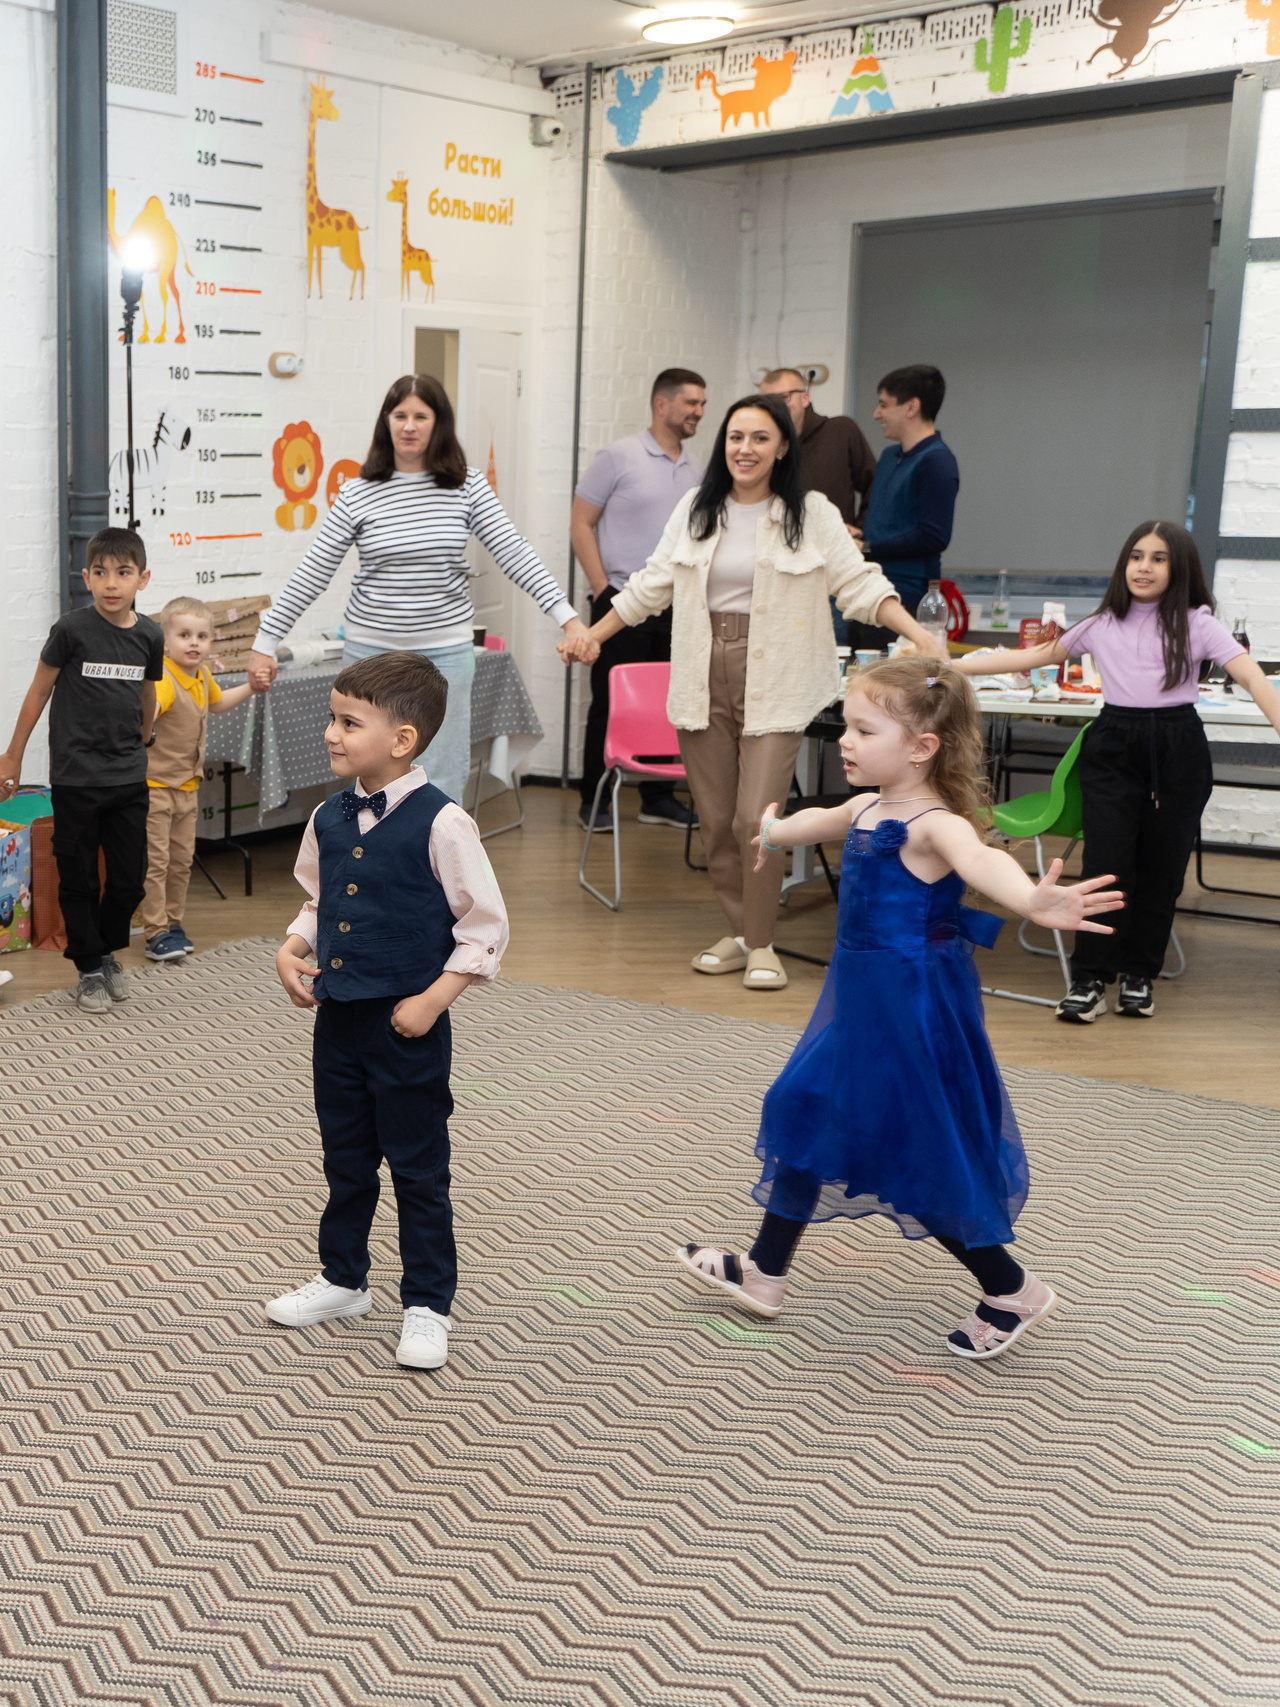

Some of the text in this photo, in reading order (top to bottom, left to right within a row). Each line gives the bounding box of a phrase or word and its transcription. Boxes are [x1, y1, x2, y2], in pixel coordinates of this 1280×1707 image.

[195, 61, 217, 79] 285
[195, 107, 216, 125] 270
[197, 149, 217, 166] 255
[444, 142, 502, 179] Расти
[169, 192, 190, 207] 240
[427, 188, 514, 226] большой!
[195, 238, 216, 253] 225
[195, 281, 216, 296] 210
[194, 325, 214, 339] 195
[169, 366, 190, 380] 180
[197, 408, 216, 422] 165
[198, 448, 217, 462] 150
[196, 490, 215, 504] 135
[169, 532, 192, 546] 120
[195, 571, 215, 584] 105
[84, 664, 113, 676] URBAN
[202, 806, 214, 820] 15
